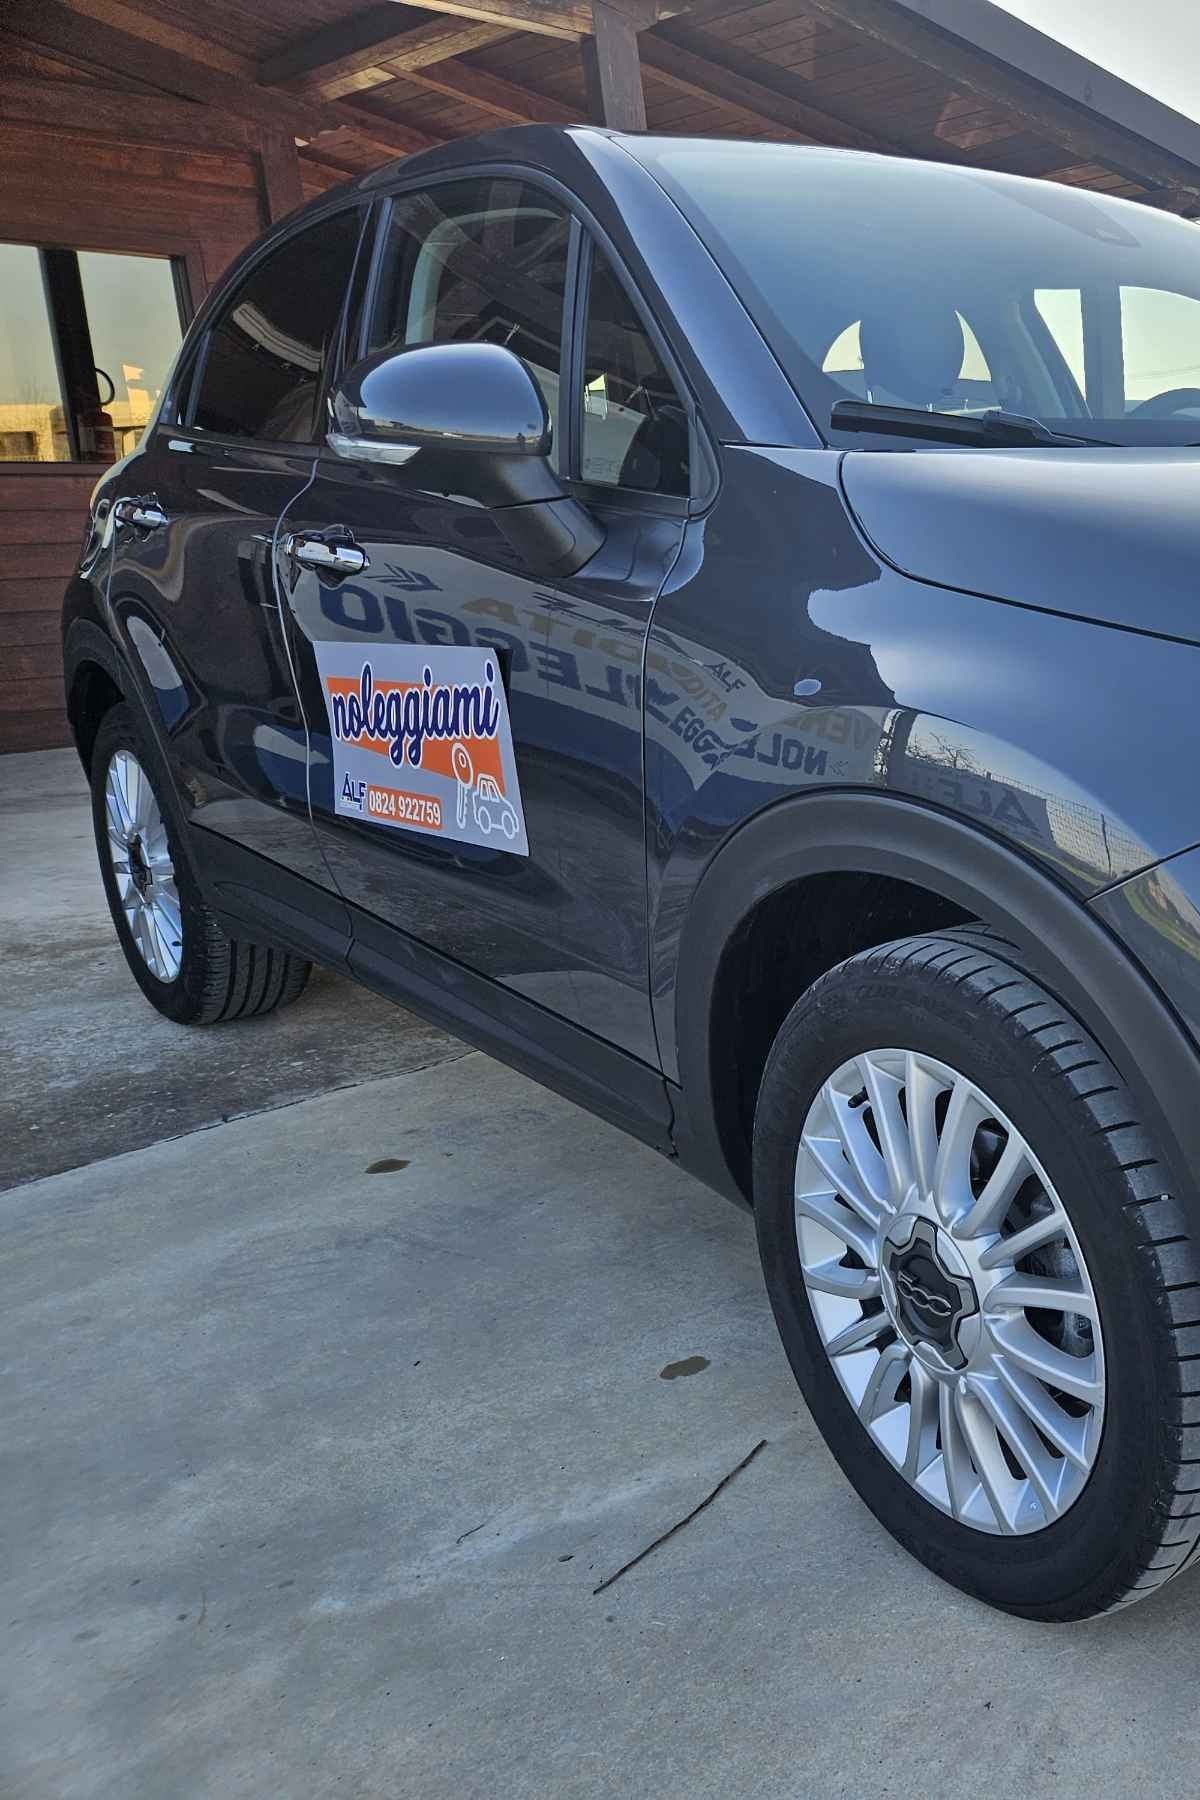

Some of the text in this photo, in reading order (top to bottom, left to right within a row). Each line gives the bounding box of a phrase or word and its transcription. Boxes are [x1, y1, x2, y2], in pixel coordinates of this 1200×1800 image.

[331, 661, 500, 766] noleggiami
[368, 790, 441, 825] 0824 922759
